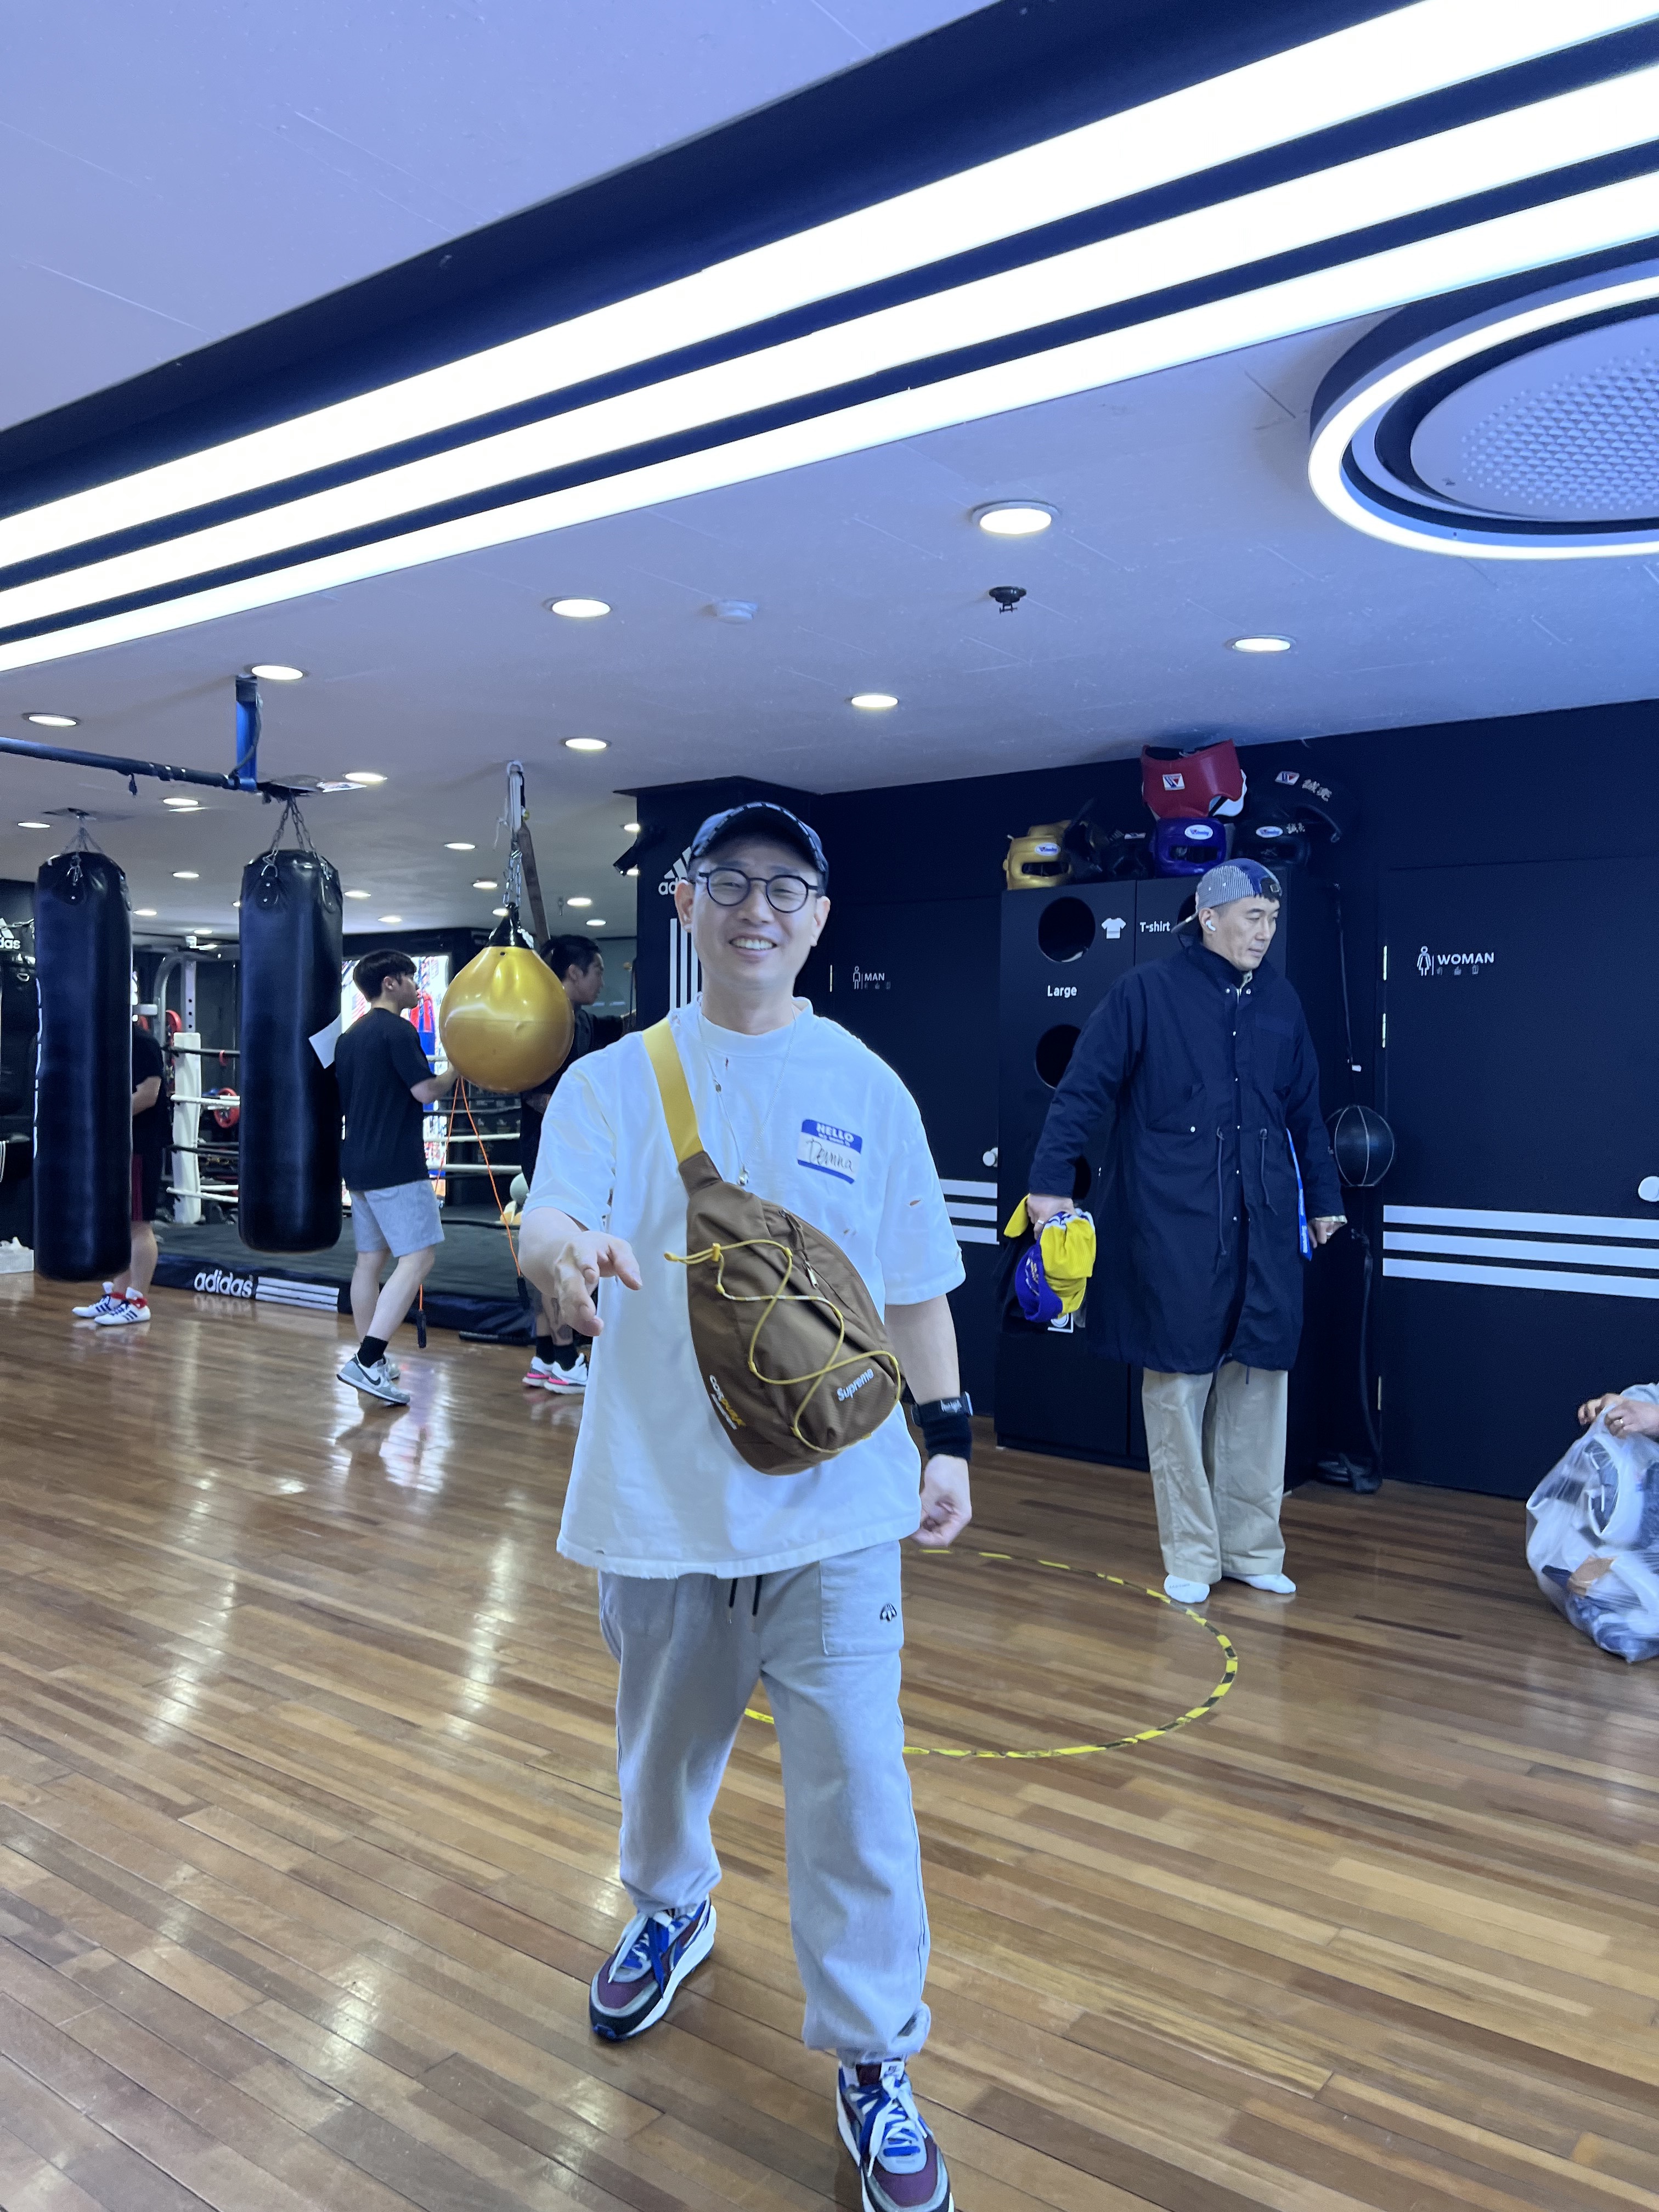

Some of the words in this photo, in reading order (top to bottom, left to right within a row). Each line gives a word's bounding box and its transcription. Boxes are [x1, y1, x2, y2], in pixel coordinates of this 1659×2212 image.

[1140, 921, 1171, 933] T-shirt
[1437, 952, 1494, 965] WOMAN
[864, 973, 885, 981] MAN
[1047, 985, 1077, 998] Large
[816, 1122, 855, 1143] HELLO
[194, 1269, 253, 1299] adidas
[837, 1368, 874, 1402] Supreme
